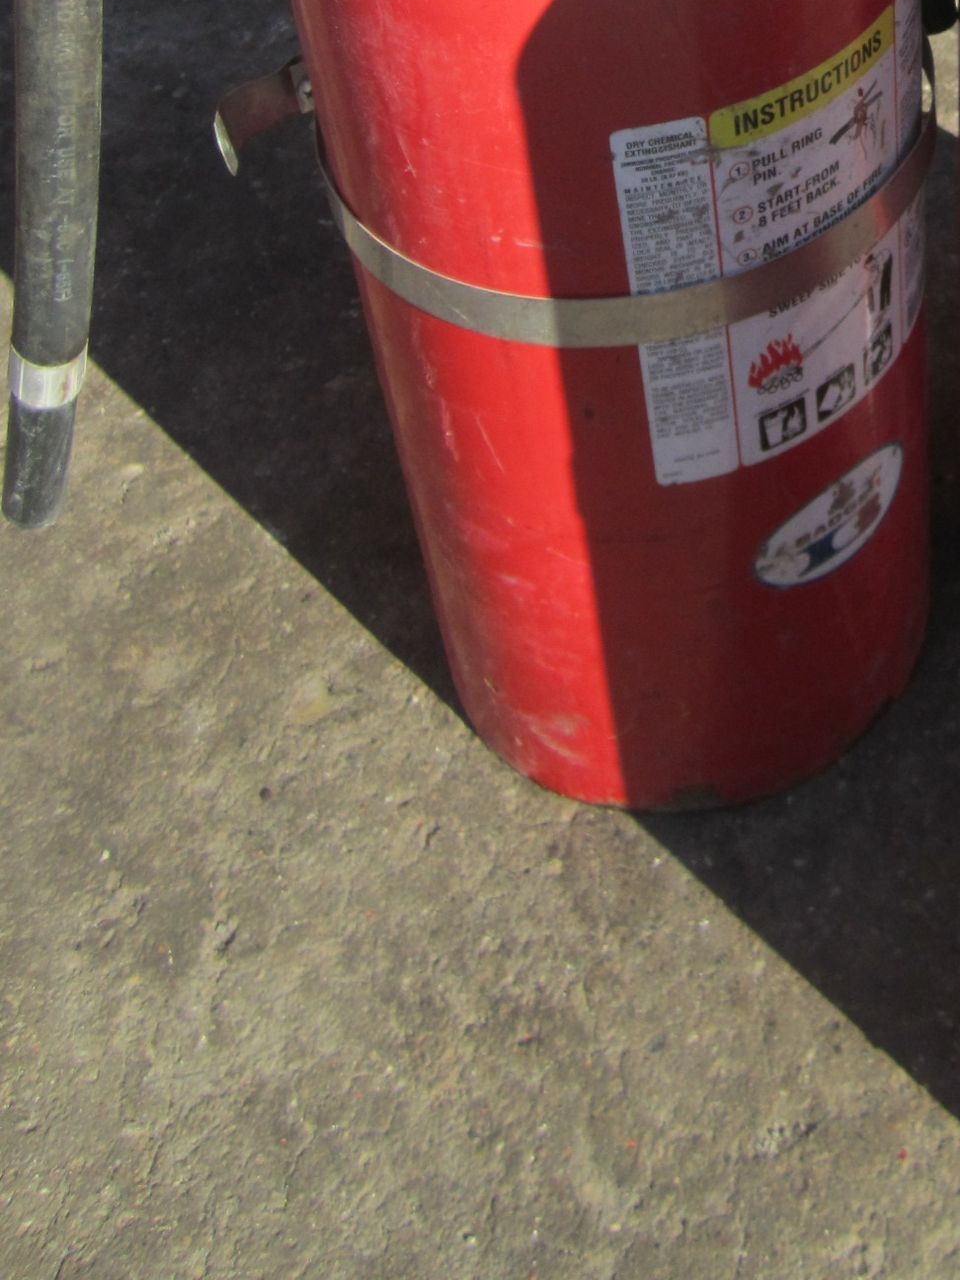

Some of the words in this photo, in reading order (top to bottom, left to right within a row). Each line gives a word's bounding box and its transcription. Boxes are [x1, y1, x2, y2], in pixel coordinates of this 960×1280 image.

[734, 30, 882, 137] INSTRUCTIONS
[57, 105, 77, 138] FOR
[626, 140, 645, 150] DRY
[647, 131, 695, 147] CHEMICAL
[751, 147, 789, 171] PULL
[791, 127, 823, 154] RING
[757, 185, 804, 214] START
[804, 160, 840, 190] FROM
[762, 234, 789, 255] AIM
[793, 222, 810, 240] AT
[813, 201, 843, 228] BASE
[847, 188, 860, 204] OF
[772, 199, 802, 221] FEET
